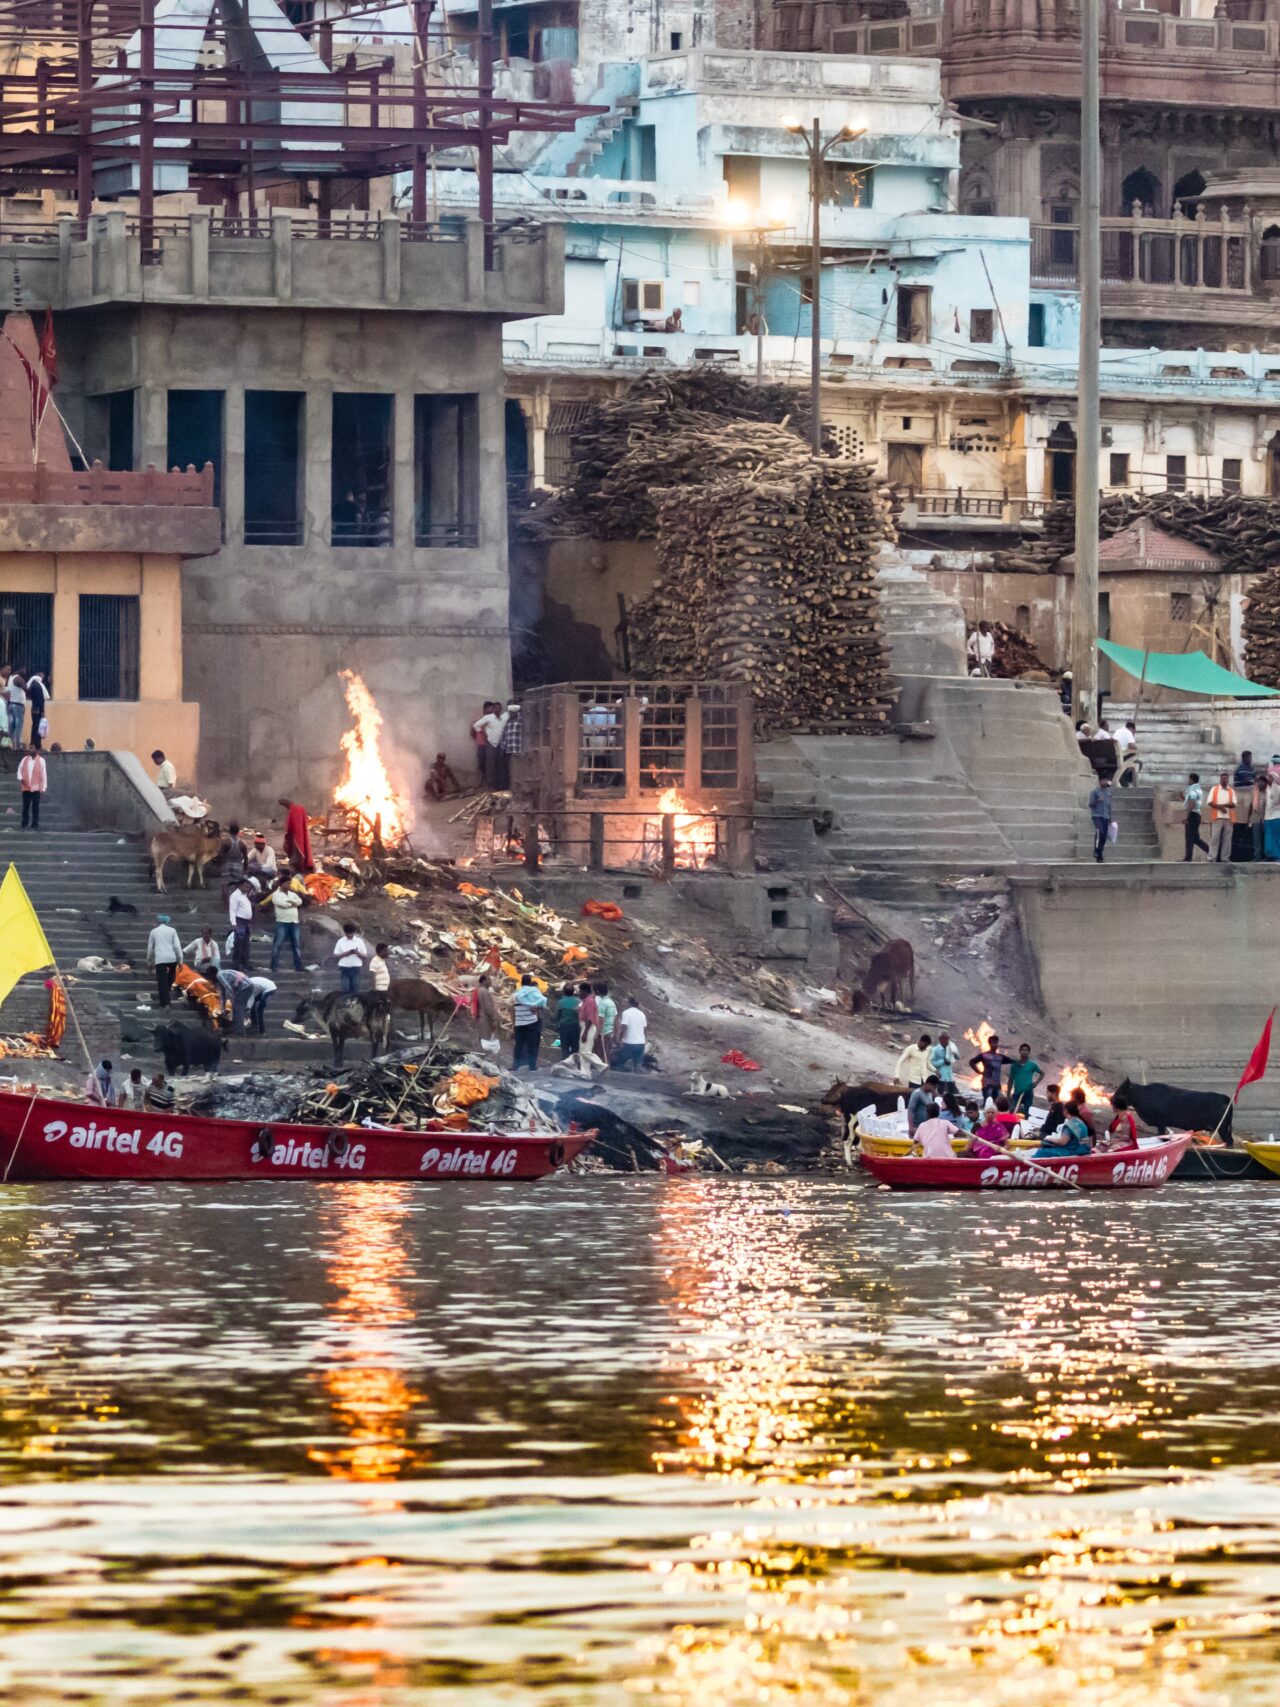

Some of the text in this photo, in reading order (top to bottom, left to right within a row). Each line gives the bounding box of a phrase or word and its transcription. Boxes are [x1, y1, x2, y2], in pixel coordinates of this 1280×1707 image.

[70, 1122, 183, 1158] airtel 4G
[271, 1139, 330, 1169] airtel
[438, 1147, 518, 1174] airtel 4G
[999, 1166, 1052, 1186] airtel
[1123, 1160, 1156, 1184] airtel
